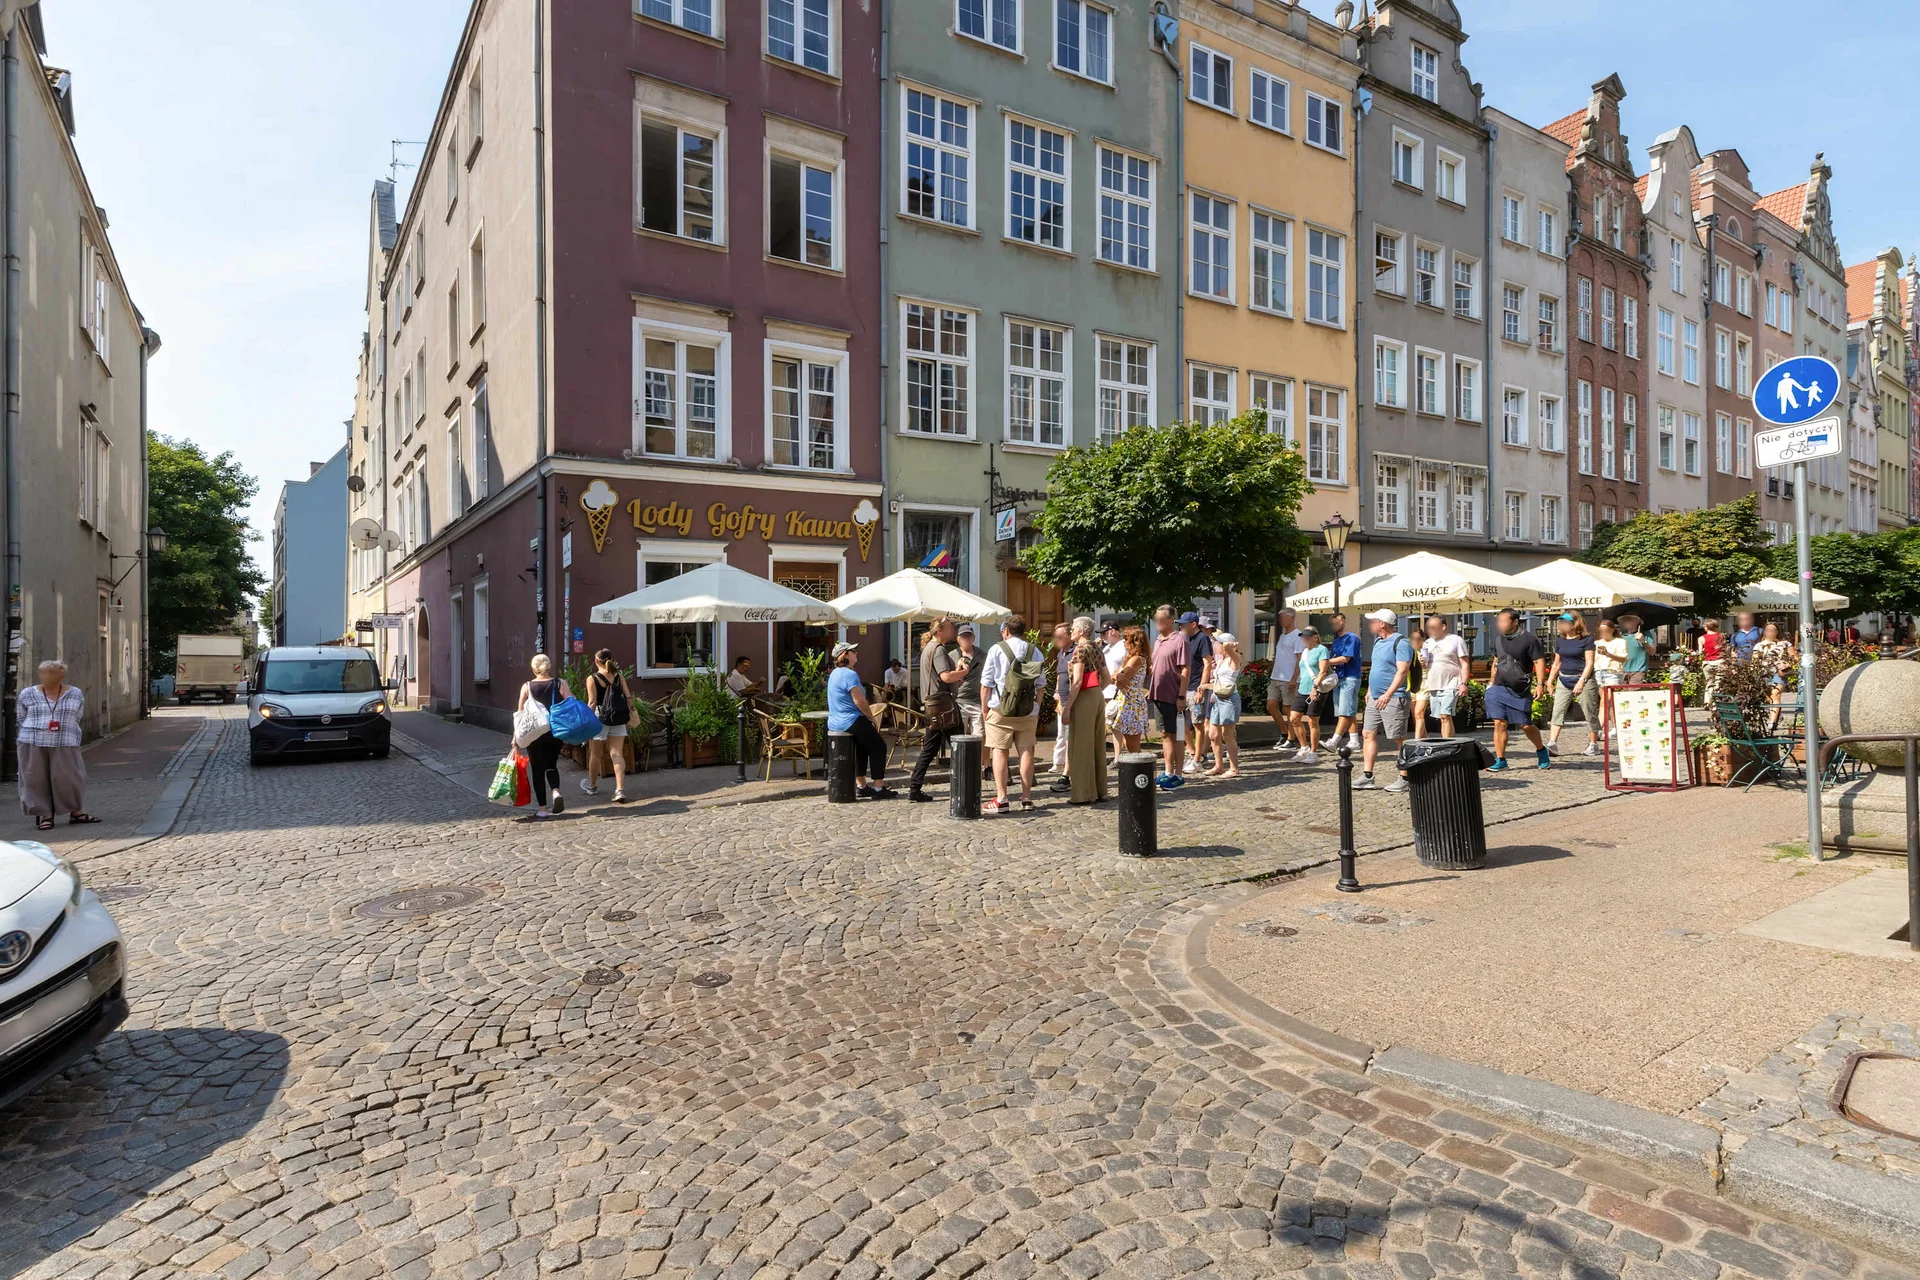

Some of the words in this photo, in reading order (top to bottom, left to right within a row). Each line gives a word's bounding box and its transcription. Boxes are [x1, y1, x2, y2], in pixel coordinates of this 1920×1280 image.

[1761, 435, 1781, 444] Nie
[1788, 424, 1834, 438] dotyczy
[626, 498, 693, 536] Lody
[707, 502, 776, 540] Gofry
[785, 510, 852, 539] Kawa
[858, 577, 867, 586] 13
[1402, 586, 1449, 598] KSIĄŻĘCE
[1292, 596, 1329, 608] KSIĄŻĘCE
[1563, 596, 1602, 606] SIĄŻĘCE
